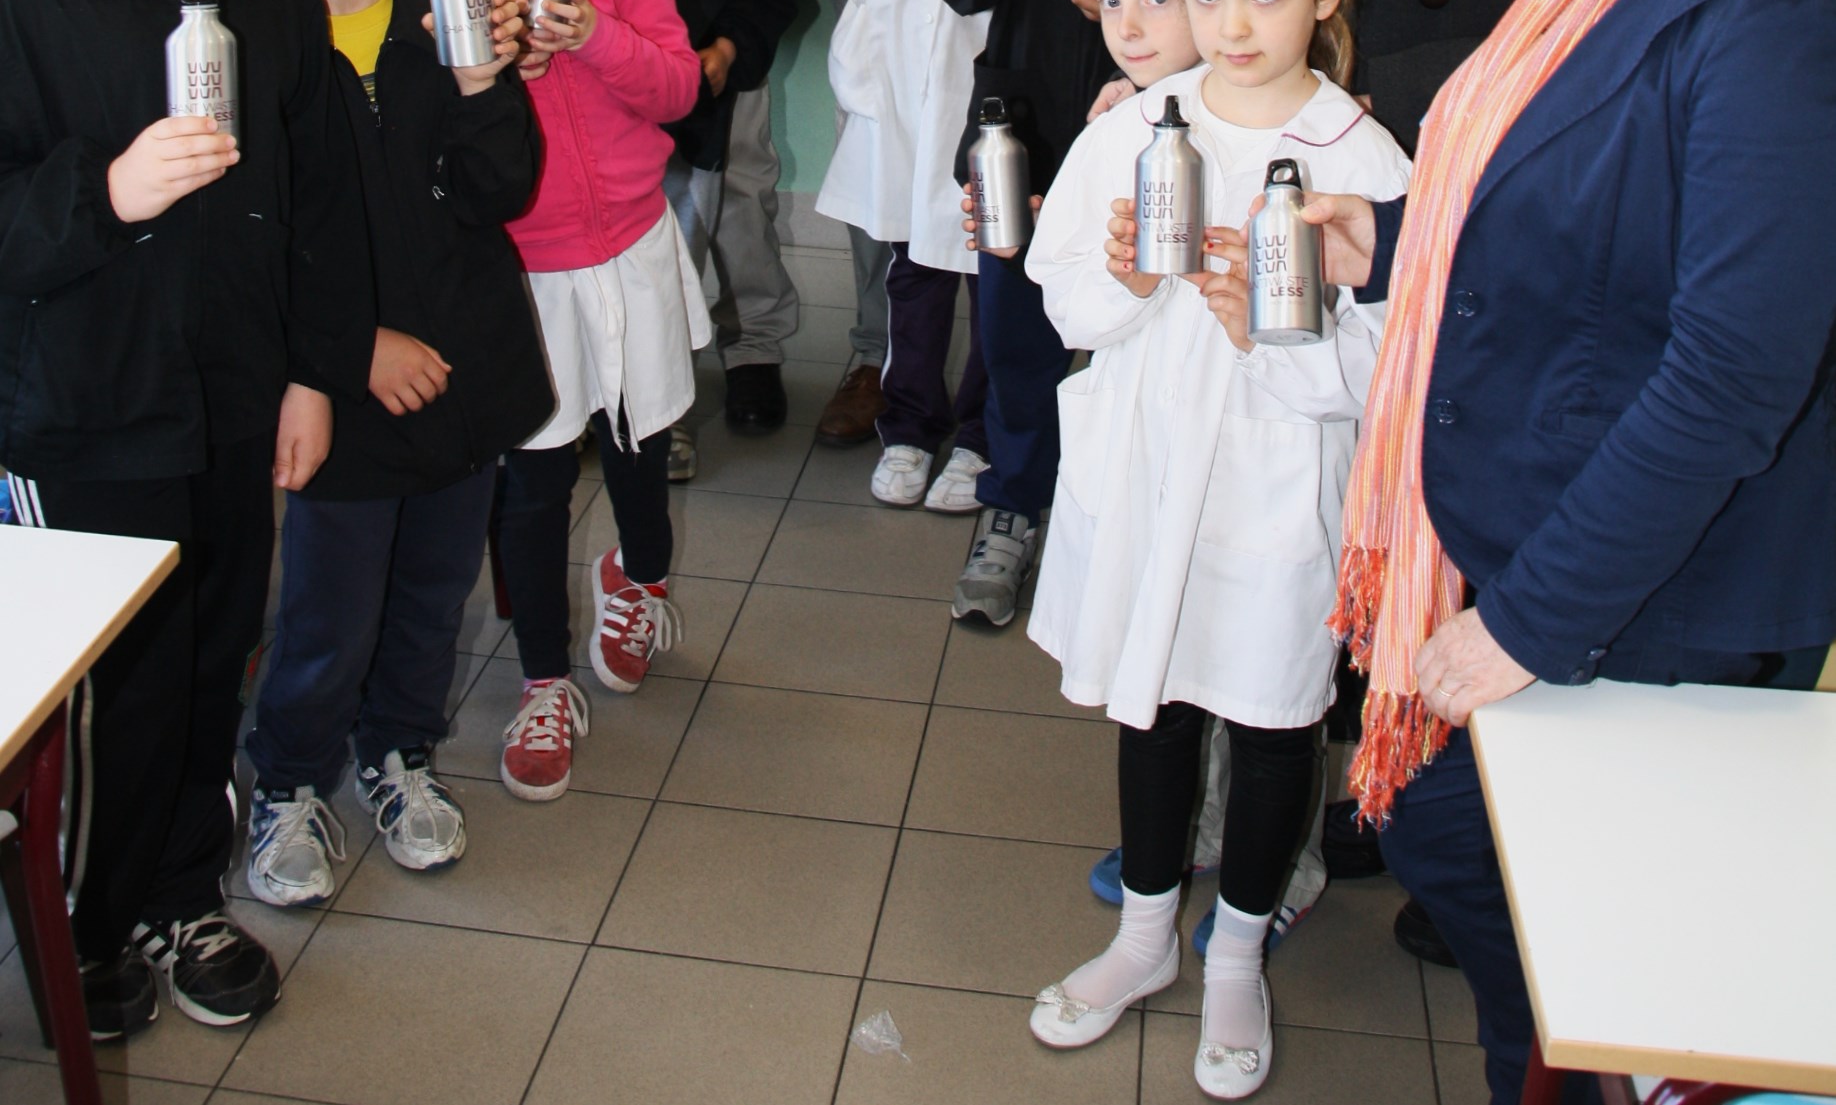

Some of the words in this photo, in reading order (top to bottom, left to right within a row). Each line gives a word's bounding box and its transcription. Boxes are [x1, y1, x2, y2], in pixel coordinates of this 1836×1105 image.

[206, 111, 234, 121] ESS
[1156, 233, 1189, 244] LESS
[1270, 286, 1305, 298] LESS
